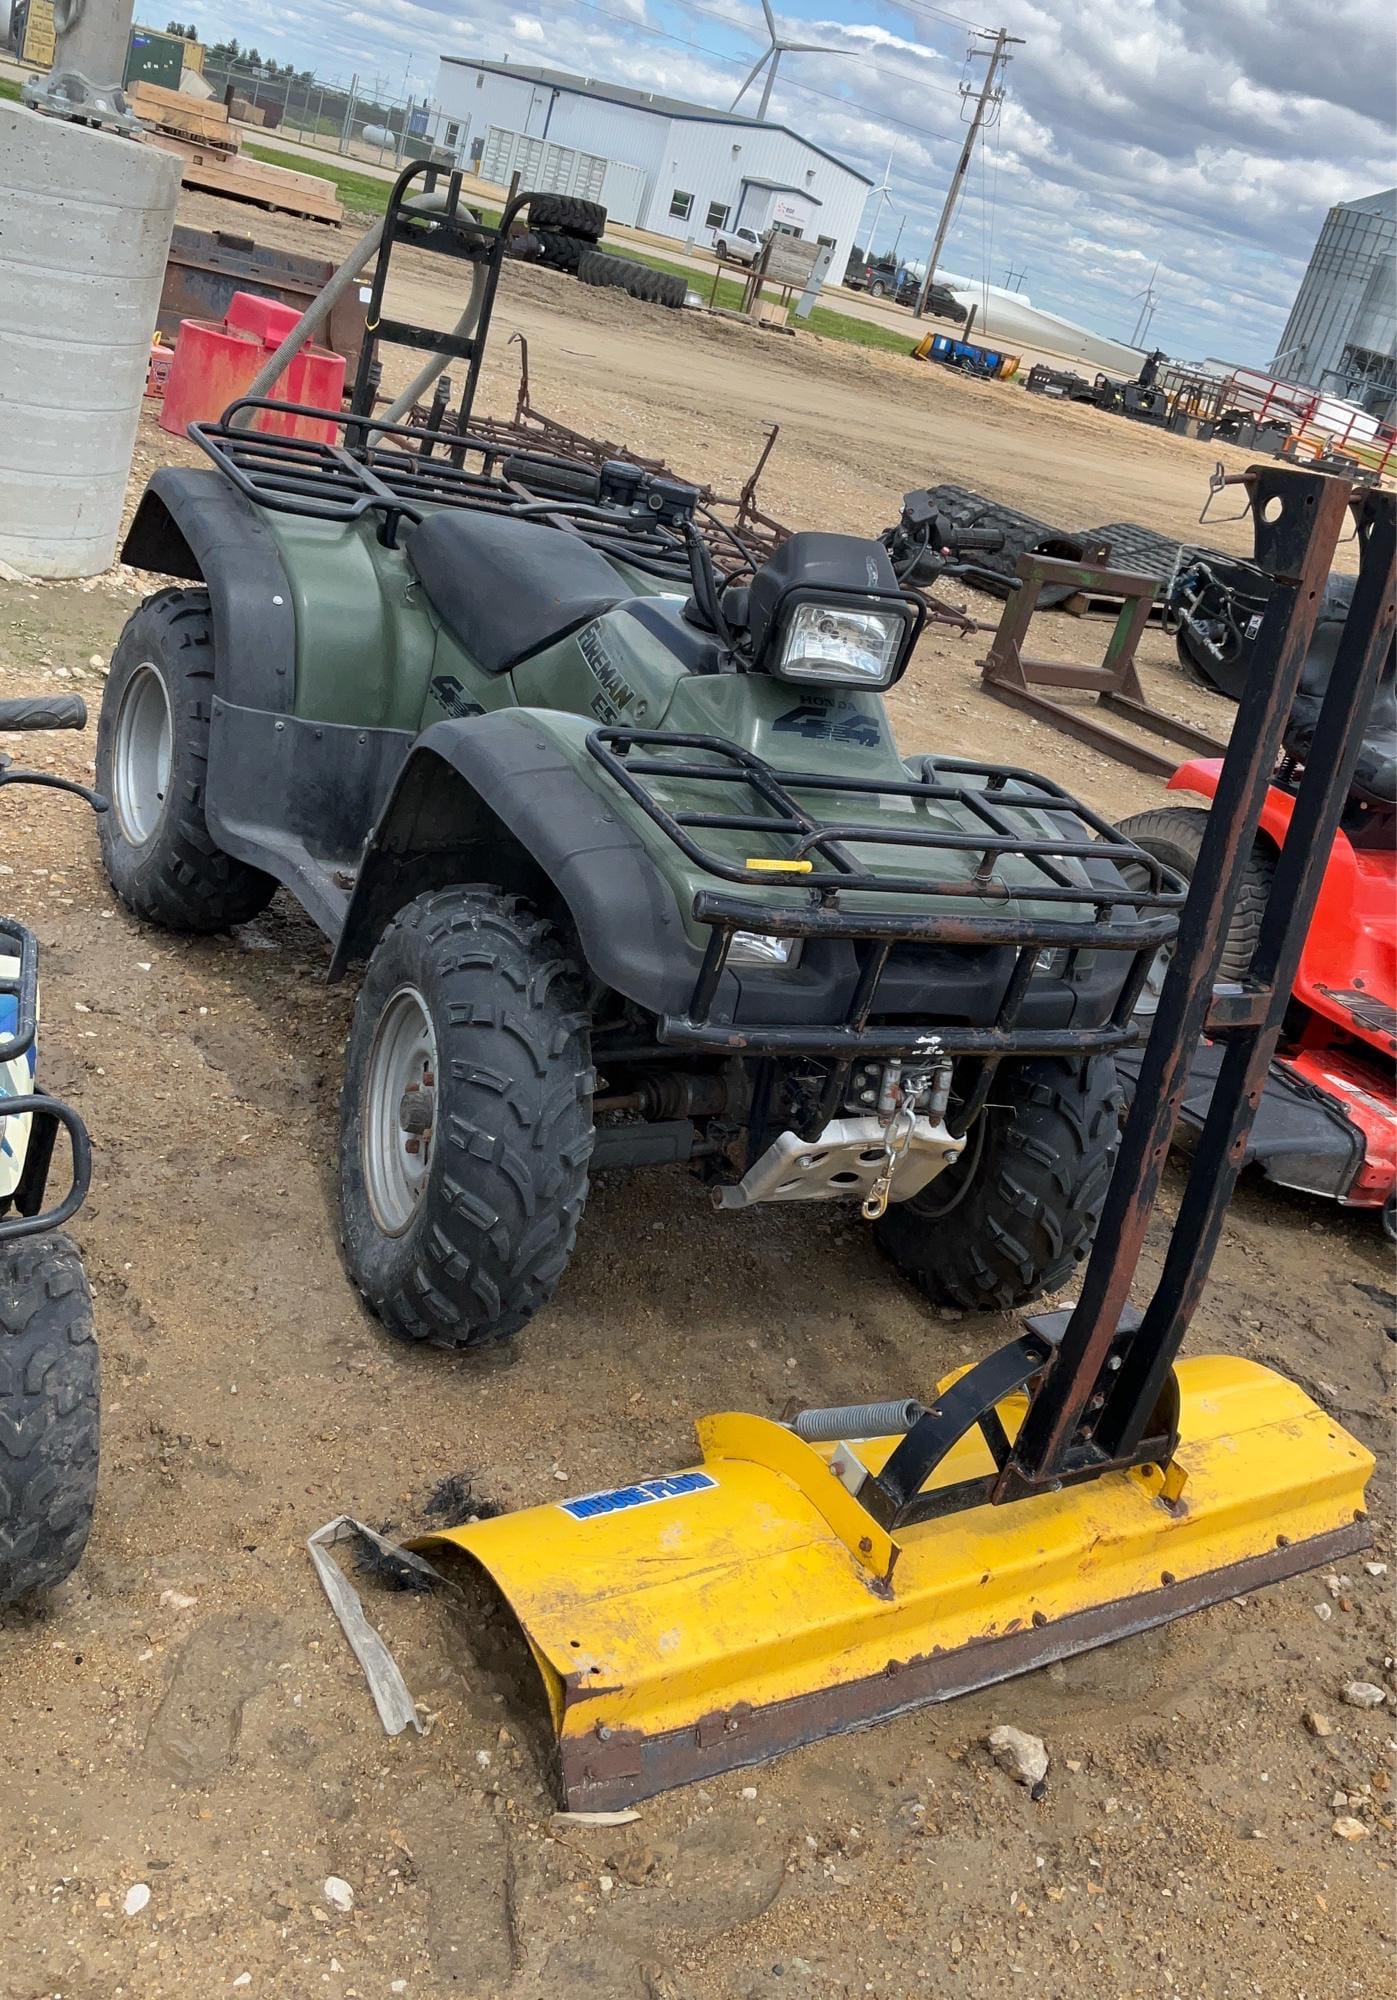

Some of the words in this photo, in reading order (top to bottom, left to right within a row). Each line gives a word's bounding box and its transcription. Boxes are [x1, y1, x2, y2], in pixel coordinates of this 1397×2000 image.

[577, 619, 636, 711] FOREMAN
[590, 692, 619, 726] ES
[799, 694, 858, 712] HONDA
